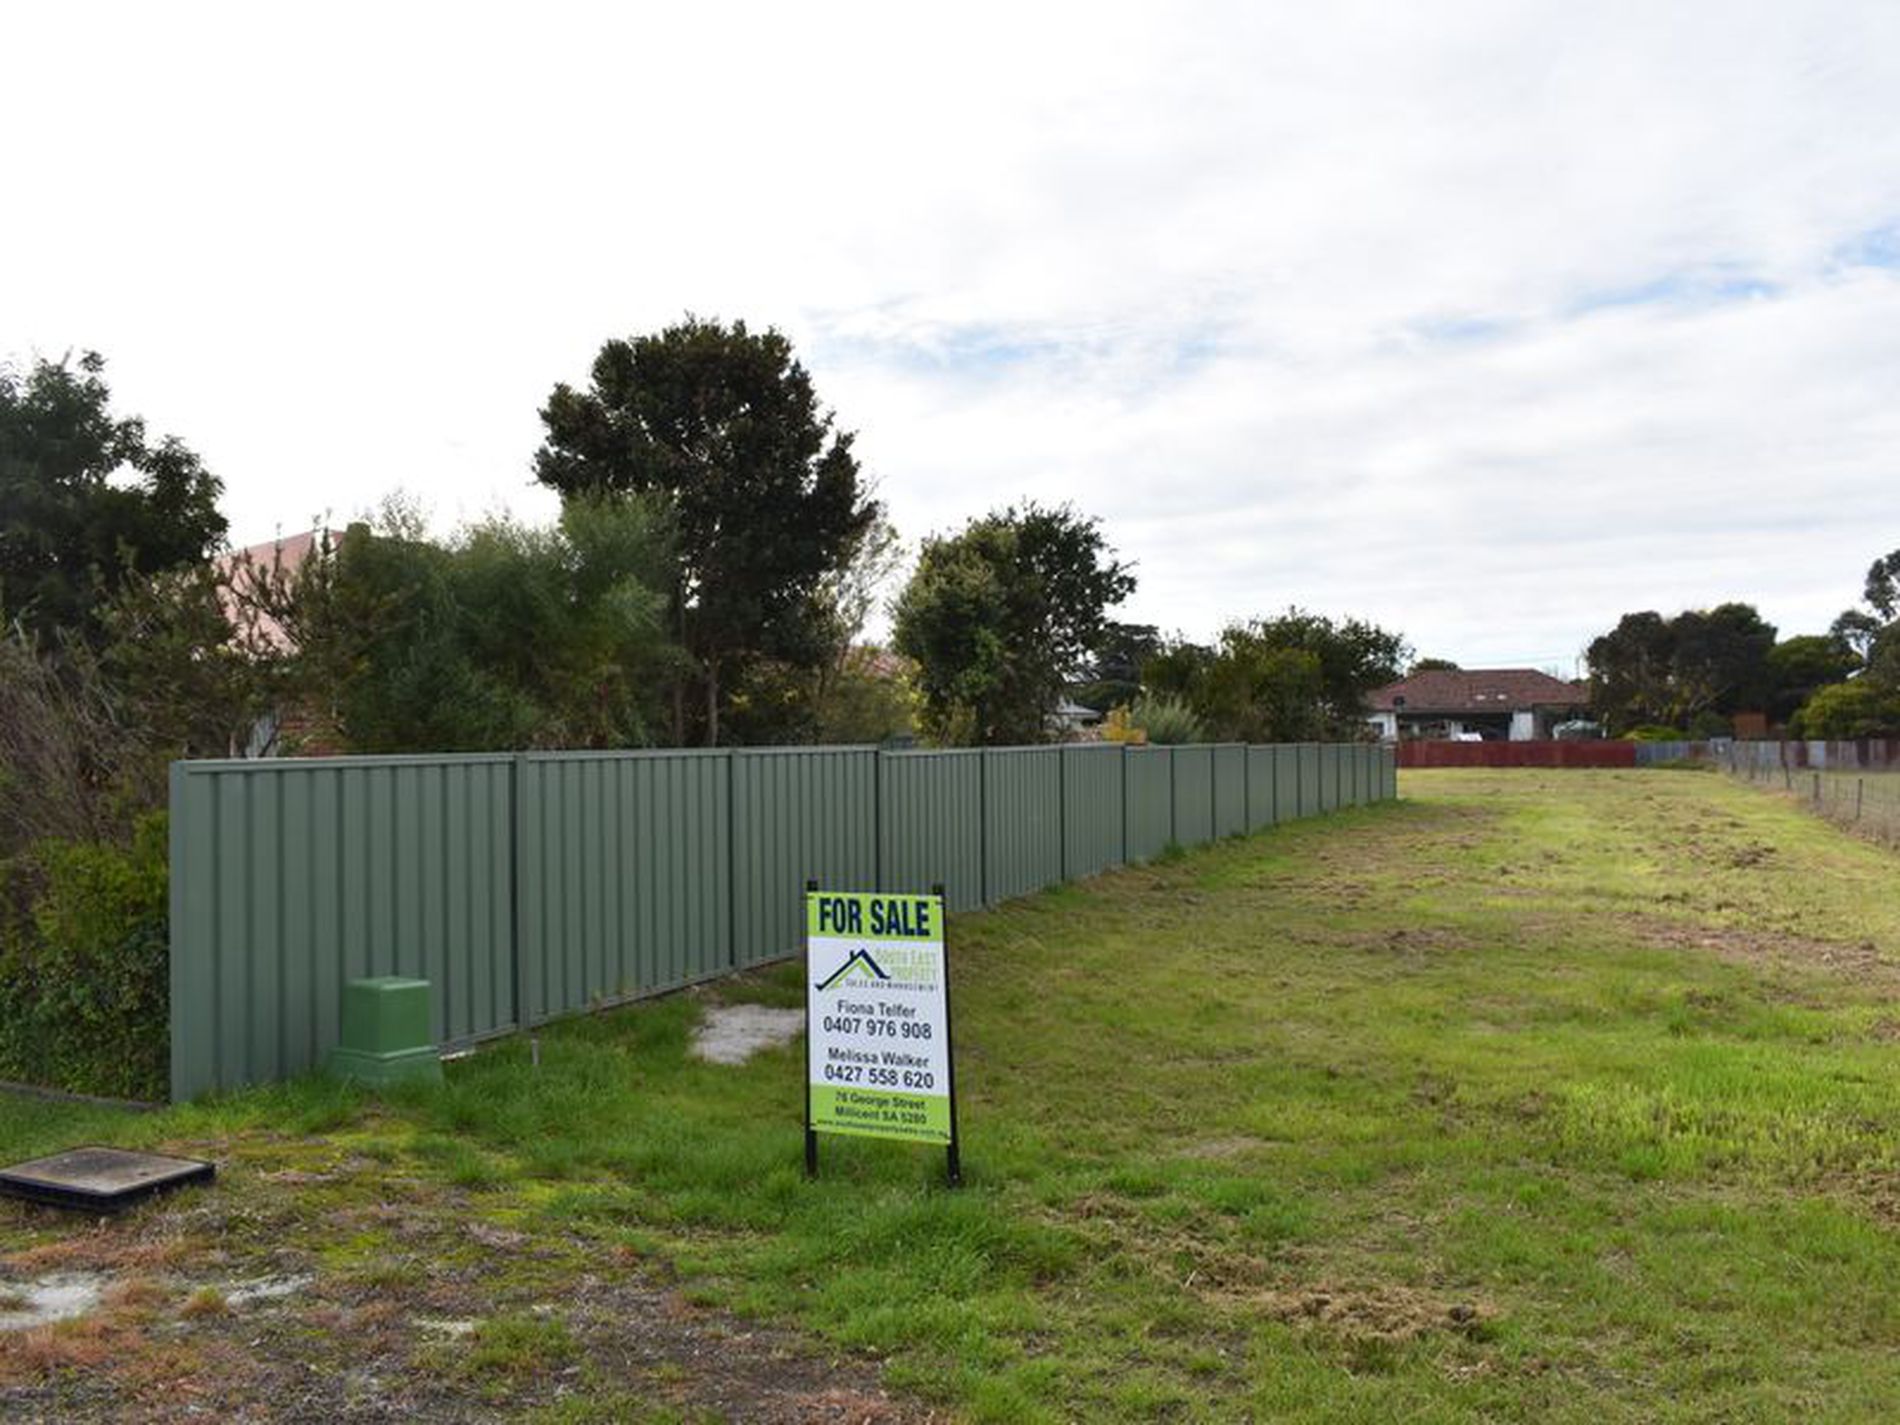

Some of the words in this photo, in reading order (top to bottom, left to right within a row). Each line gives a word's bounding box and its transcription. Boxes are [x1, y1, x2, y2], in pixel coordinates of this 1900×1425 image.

[819, 898, 862, 933] FOR
[870, 900, 930, 936] SALE
[838, 1000, 874, 1015] Fiona
[878, 1002, 916, 1018] Telfer
[823, 1016, 861, 1033] 0407
[866, 1019, 896, 1036] 976
[902, 1022, 932, 1039] 908
[828, 1048, 878, 1064] Melissa
[882, 1052, 930, 1068] Walker
[824, 1064, 863, 1082] 0427
[868, 1068, 898, 1086] 558
[904, 1071, 934, 1088] 620
[850, 1093, 890, 1109] George
[892, 1096, 926, 1110] Street
